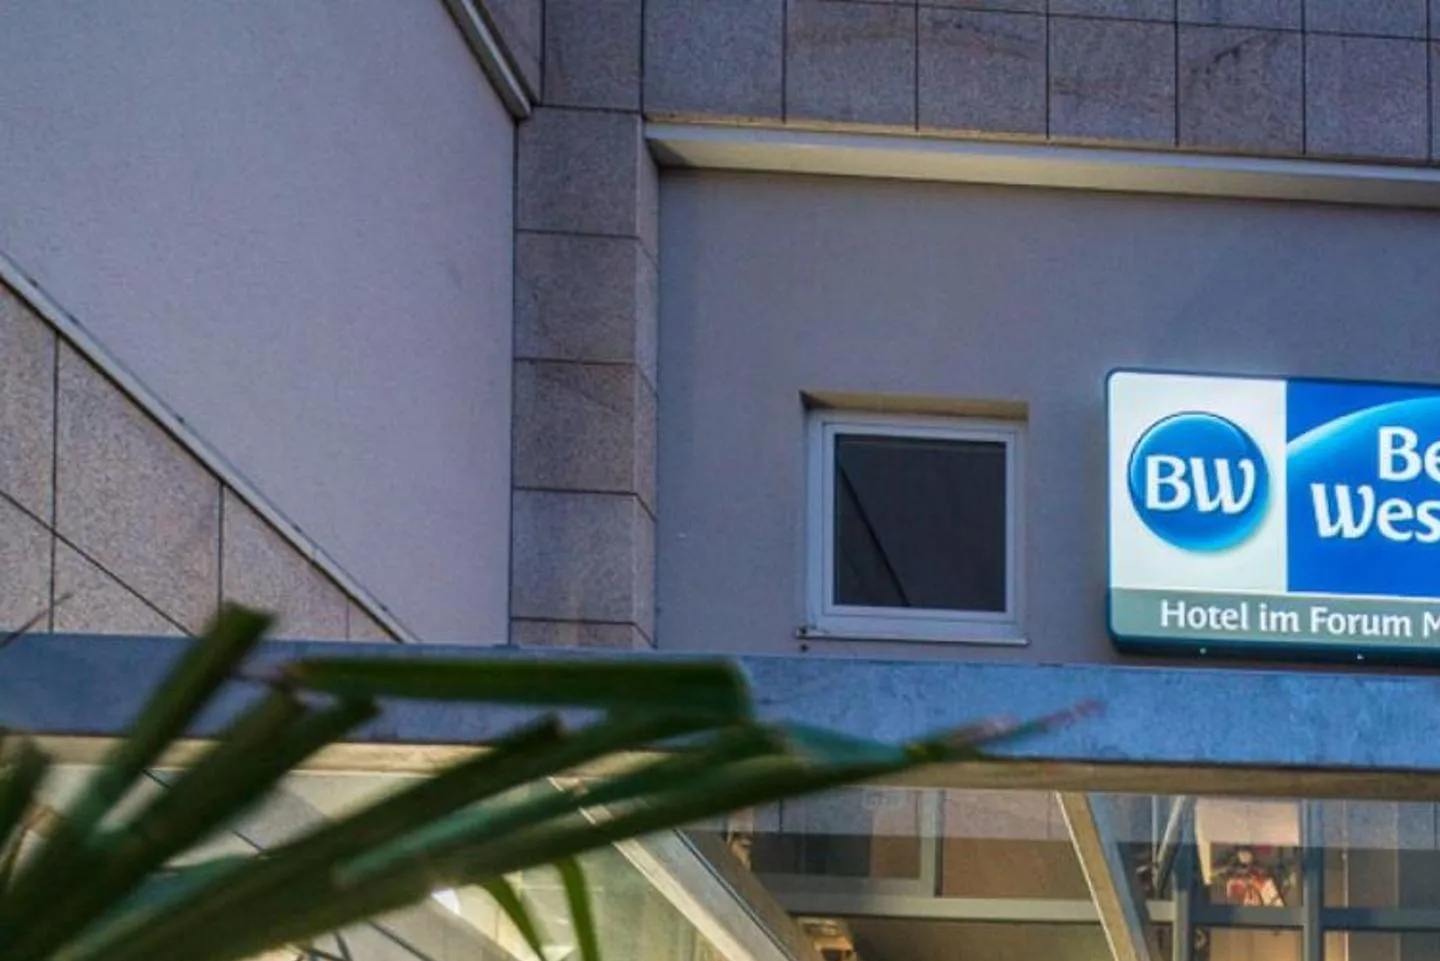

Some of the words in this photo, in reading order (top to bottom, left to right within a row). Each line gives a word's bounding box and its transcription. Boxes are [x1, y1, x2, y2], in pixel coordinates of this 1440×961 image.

[1146, 454, 1255, 514] BW
[1160, 599, 1249, 632] Hotel
[1259, 603, 1300, 634] im
[1310, 606, 1412, 639] Forum
